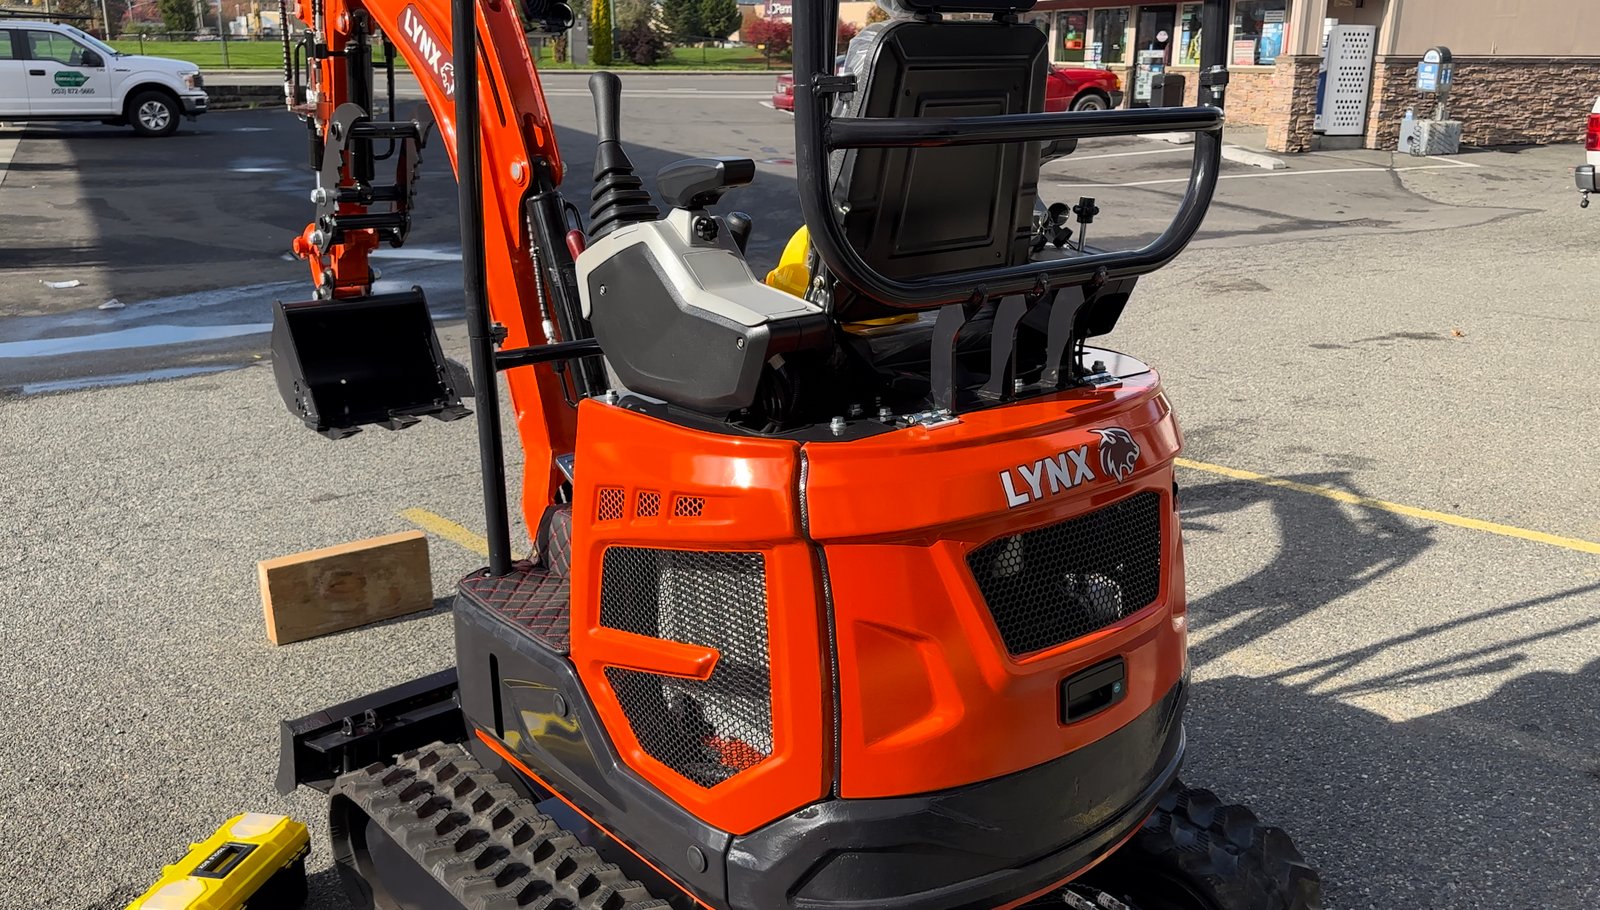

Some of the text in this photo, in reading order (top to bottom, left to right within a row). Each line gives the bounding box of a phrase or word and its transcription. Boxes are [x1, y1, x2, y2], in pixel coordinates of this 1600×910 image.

[404, 8, 441, 74] LYNX
[766, 4, 792, 14] JCPenn
[999, 444, 1096, 508] LYNX
